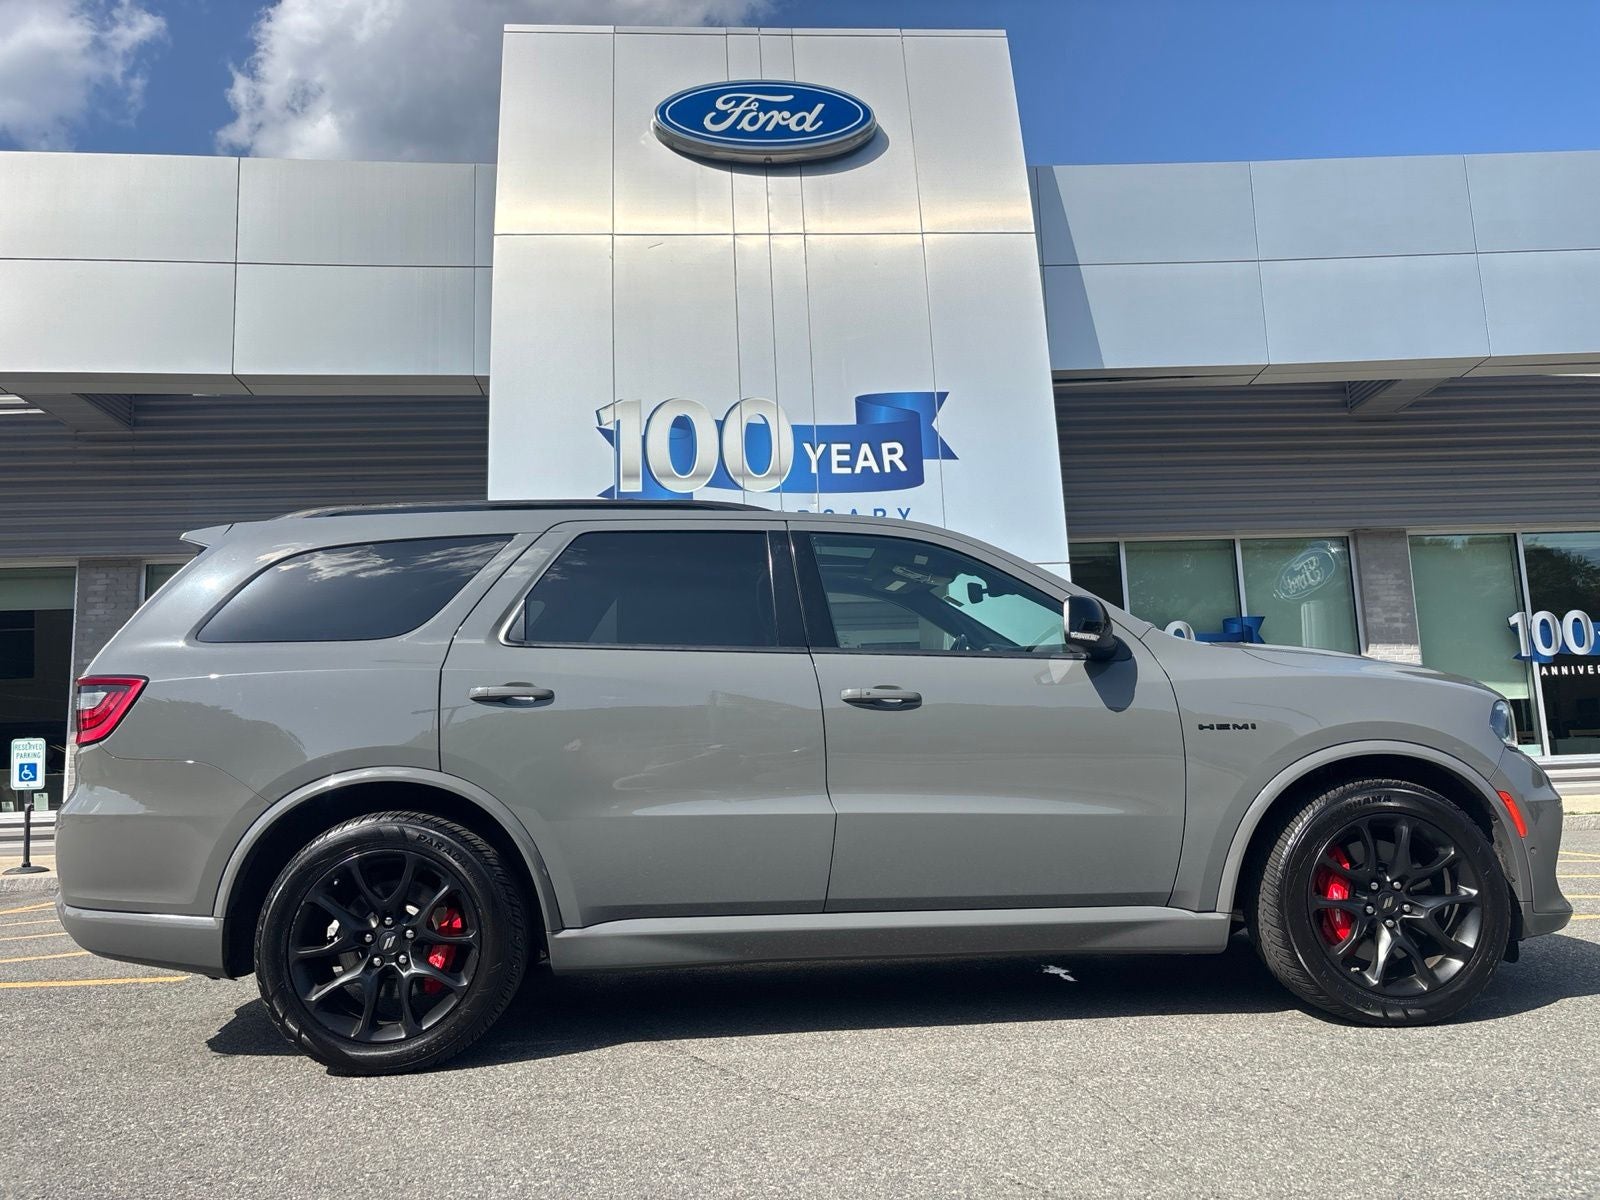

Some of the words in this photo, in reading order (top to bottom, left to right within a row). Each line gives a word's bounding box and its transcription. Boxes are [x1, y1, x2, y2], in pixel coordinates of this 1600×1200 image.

[703, 93, 825, 132] Ford
[597, 397, 795, 493] 100
[802, 441, 908, 474] YEAR
[1507, 609, 1595, 656] 100
[1541, 664, 1600, 676] ANNIVE
[15, 743, 43, 751] RESERVED
